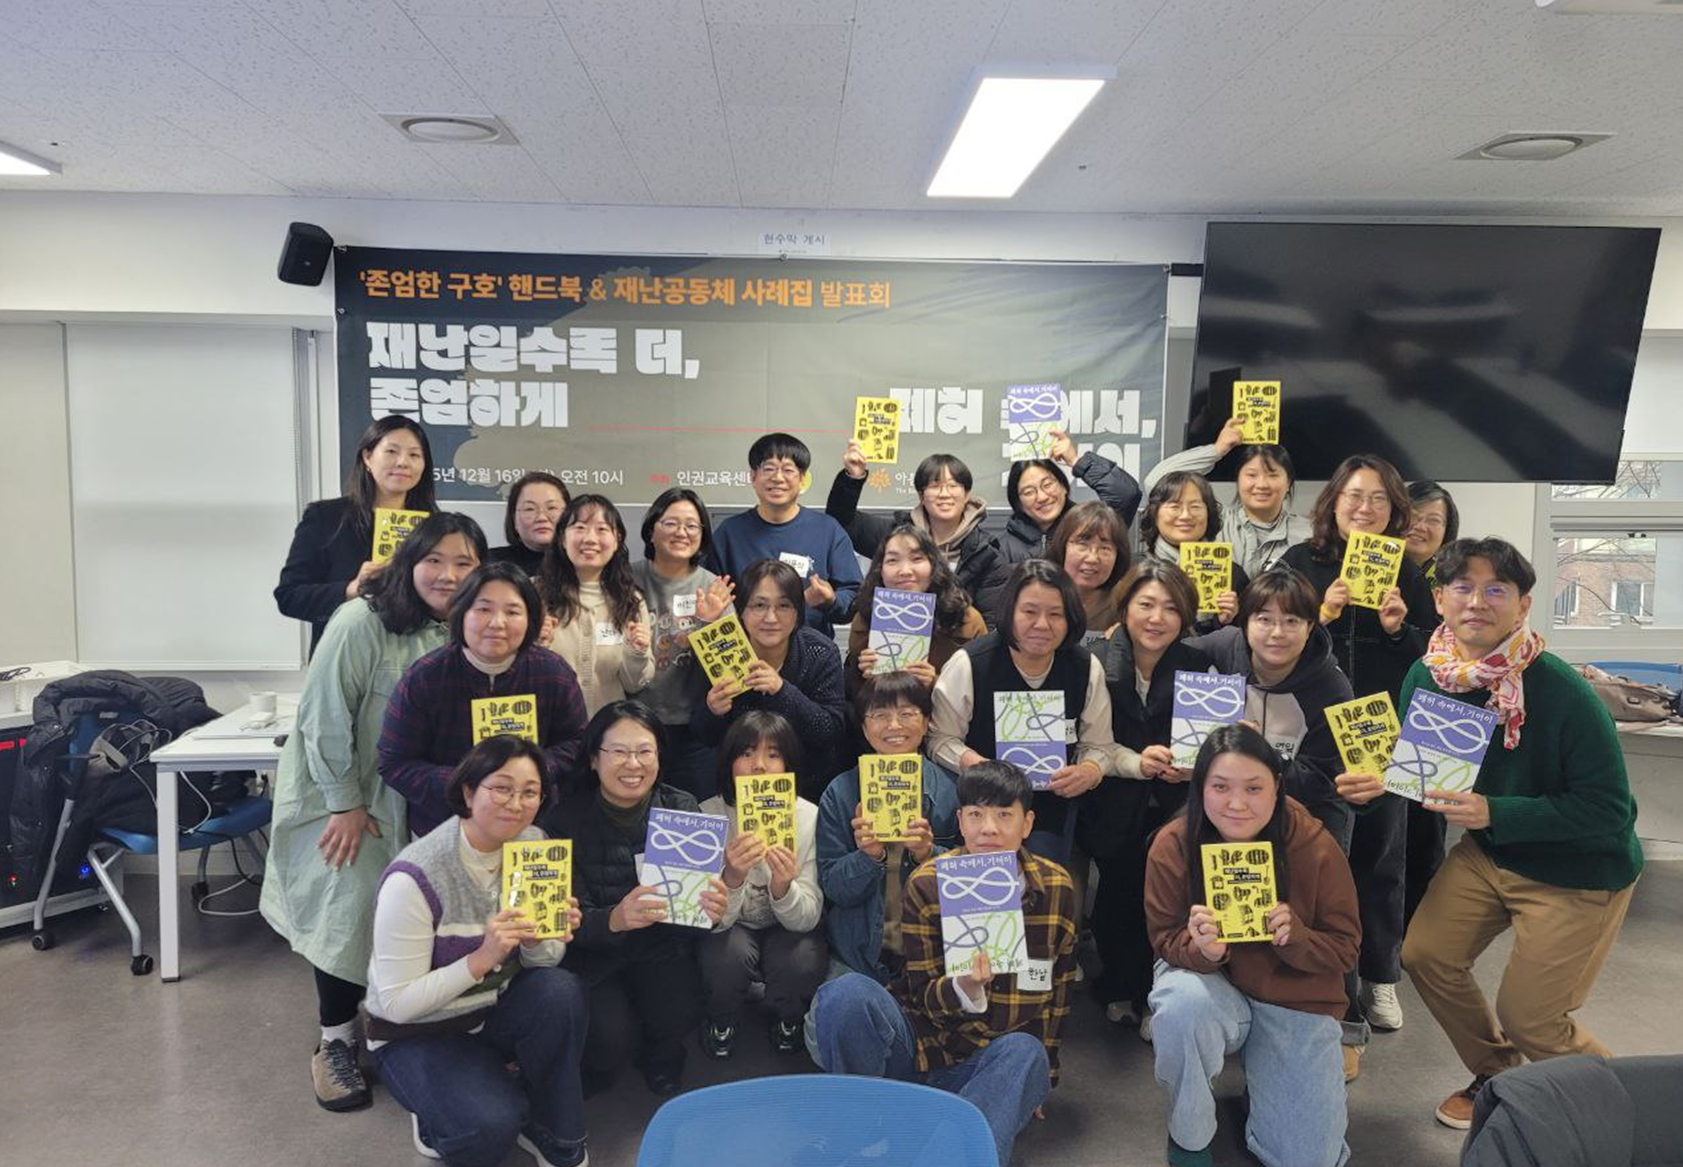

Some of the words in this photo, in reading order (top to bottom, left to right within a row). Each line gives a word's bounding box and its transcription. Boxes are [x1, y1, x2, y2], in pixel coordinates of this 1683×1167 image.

[763, 232, 796, 244] 현수막
[803, 233, 824, 244] 게시
[360, 269, 441, 299] '존엄한
[447, 272, 502, 300] 구호'
[508, 273, 583, 302] 핸드북
[589, 277, 607, 301] &
[613, 276, 735, 305] 재난공동체
[741, 279, 813, 308] 사례집
[820, 281, 891, 308] 발표회
[366, 321, 618, 374] 재난일수록
[634, 328, 700, 379] 더,
[369, 377, 569, 428] 존엄하게
[1001, 389, 1157, 438] 에서,
[433, 467, 456, 483] 5년
[459, 467, 491, 484] 12월
[561, 469, 588, 485] 오전
[591, 470, 624, 486] 10시
